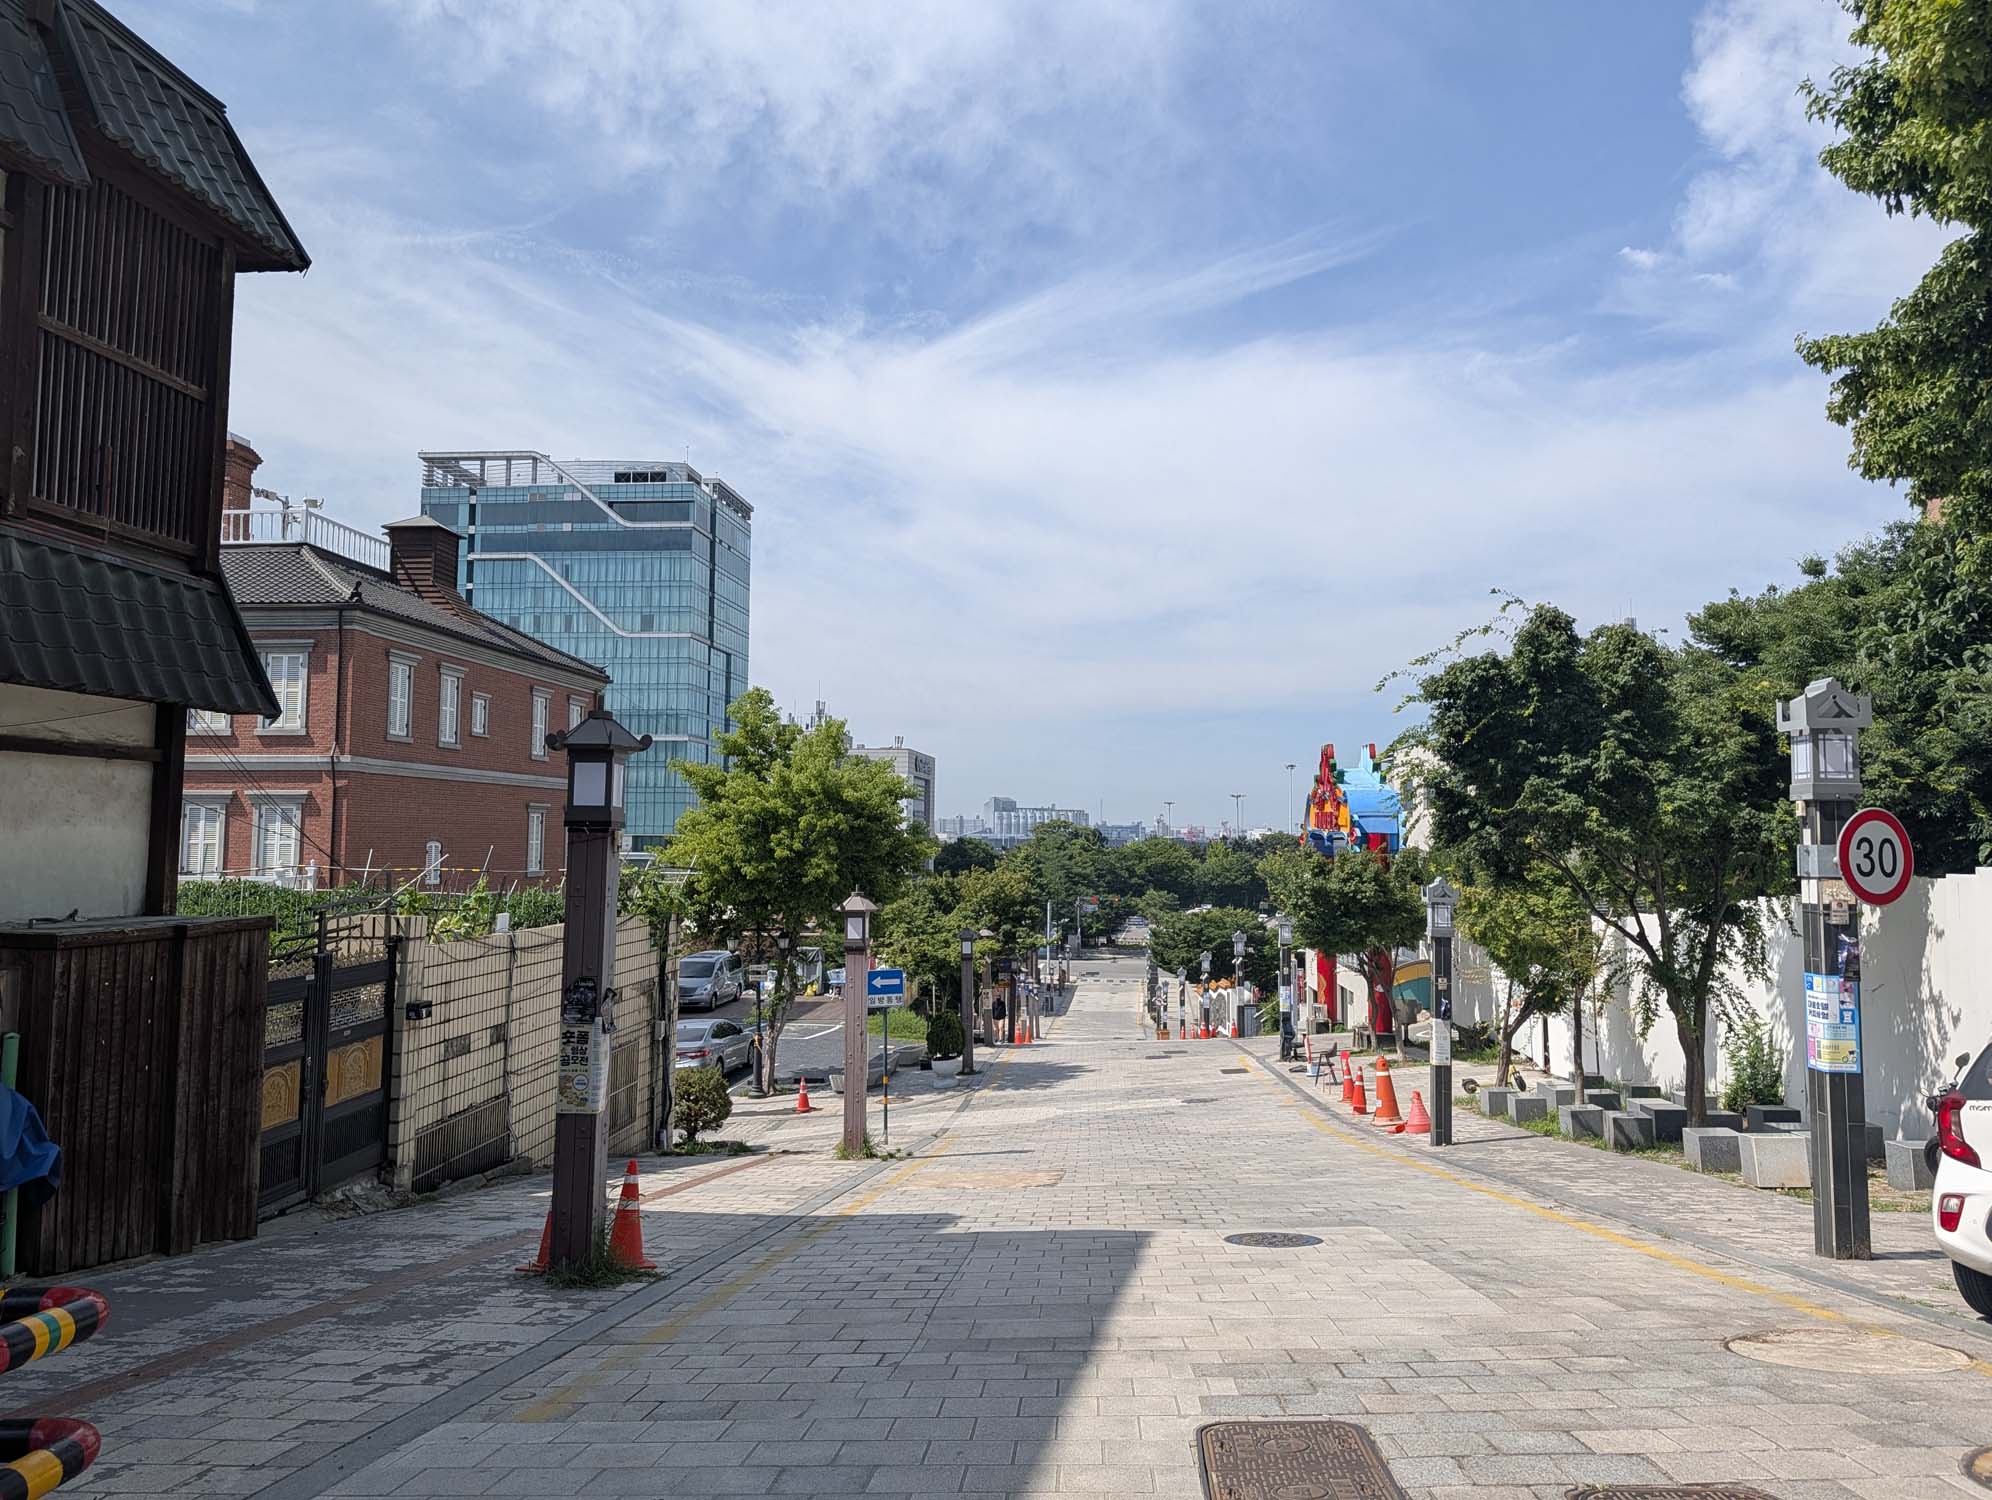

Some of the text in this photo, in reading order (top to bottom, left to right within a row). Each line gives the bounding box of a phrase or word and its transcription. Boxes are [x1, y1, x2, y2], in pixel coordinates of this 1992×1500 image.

[1856, 837, 1897, 878] 30
[868, 996, 902, 1005] 일방통행
[560, 1055, 589, 1067] 공모전
